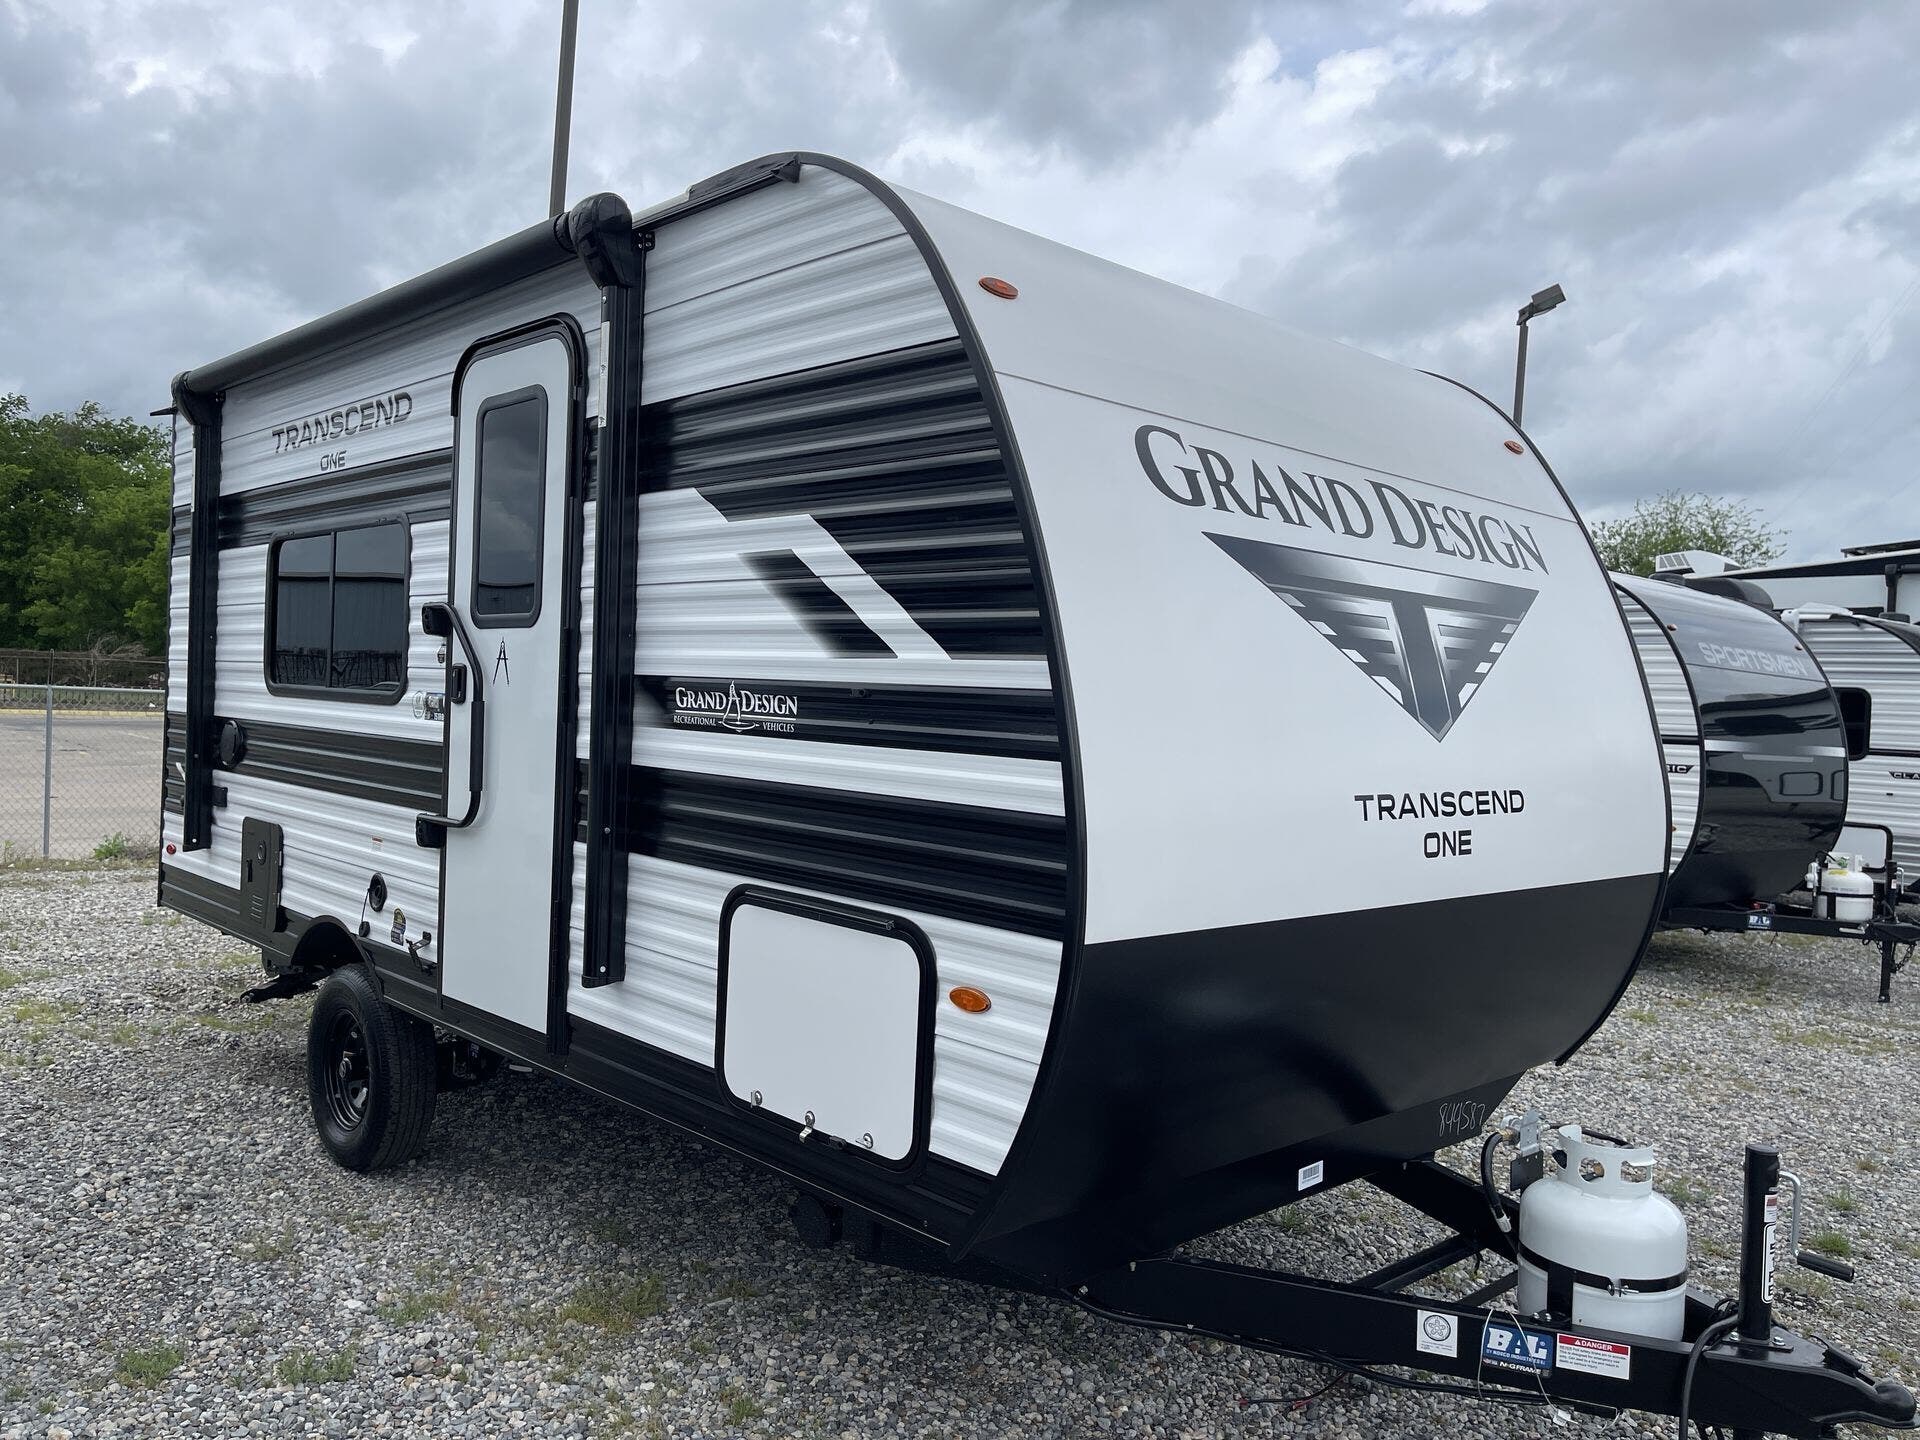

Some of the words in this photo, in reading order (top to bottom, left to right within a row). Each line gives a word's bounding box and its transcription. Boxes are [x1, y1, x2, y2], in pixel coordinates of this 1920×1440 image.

[272, 392, 412, 453] TRANSCEND
[320, 450, 347, 471] ONE
[1134, 424, 1374, 539] GRAND
[1364, 479, 1549, 576] DESIGN
[1698, 641, 1808, 676] SPORTSMEN
[675, 687, 726, 710] GRAND
[740, 690, 797, 715] DESIGN
[673, 715, 716, 726] RECREATIONAL
[762, 722, 795, 733] VEHICLES
[1354, 790, 1525, 822] TRANSCEND
[1424, 830, 1472, 858] ONE
[1439, 1101, 1486, 1136] 844587
[1487, 1327, 1548, 1360] BAL
[1581, 1340, 1613, 1351] DANGER
